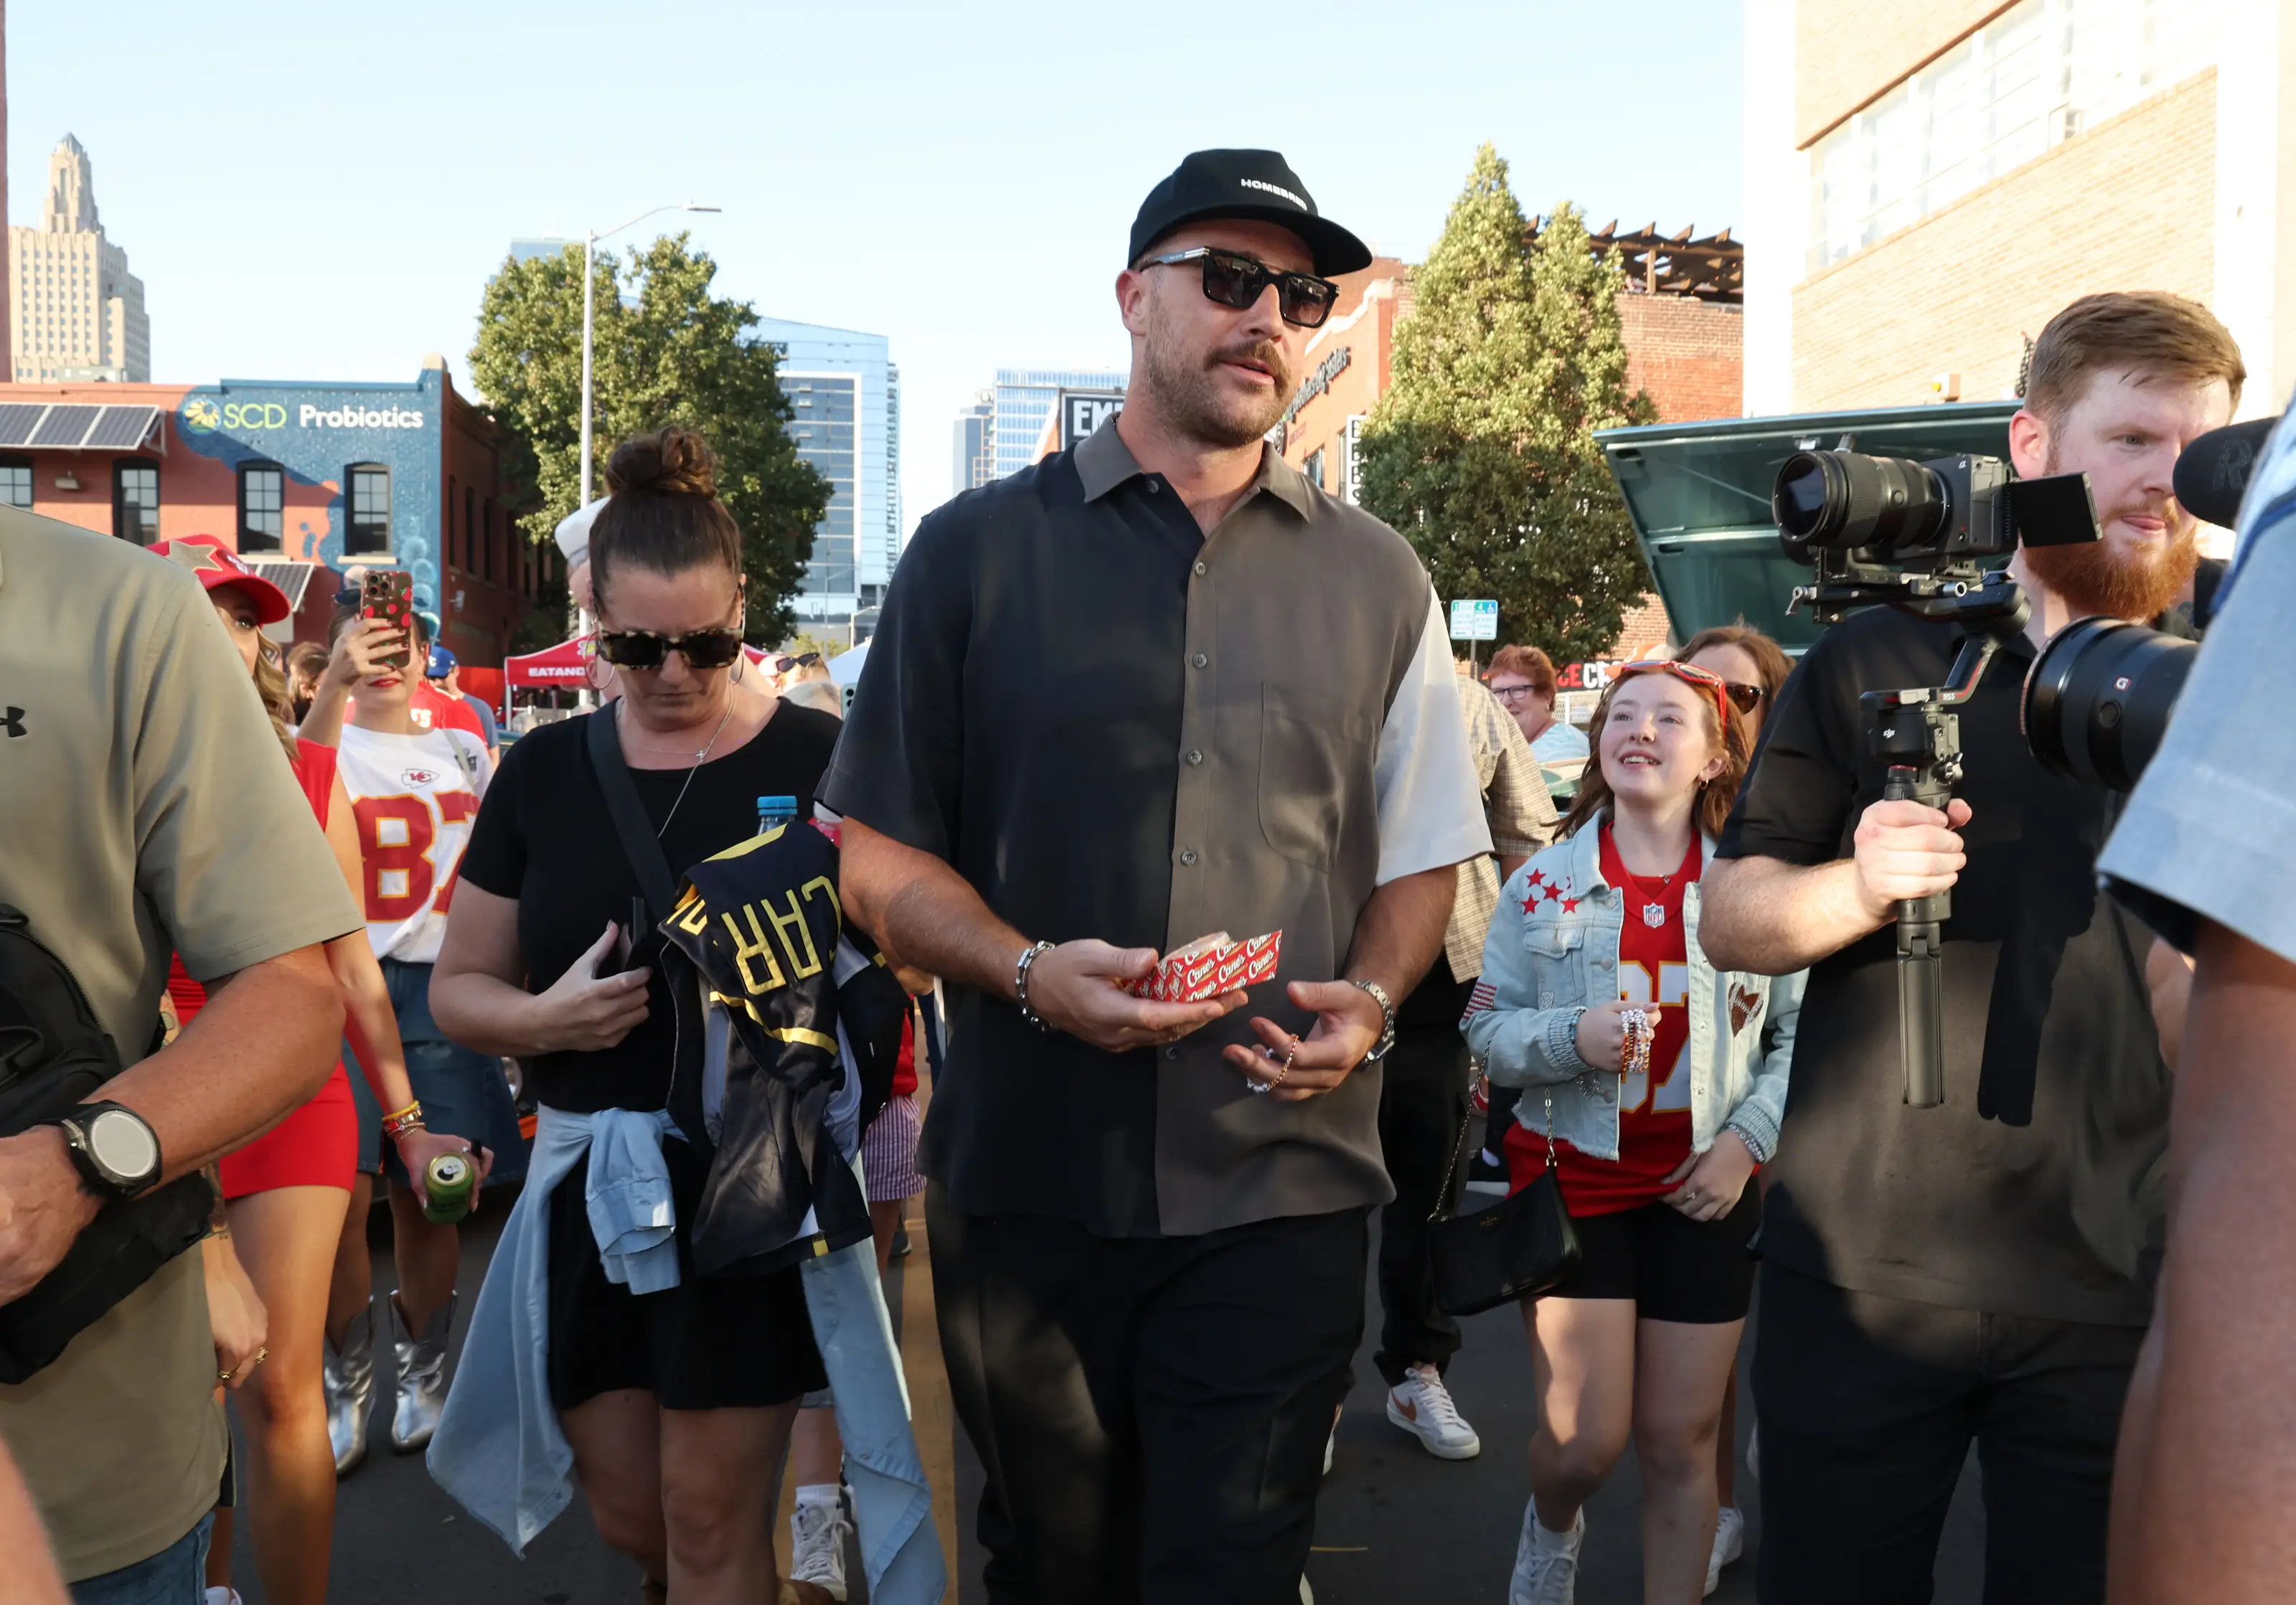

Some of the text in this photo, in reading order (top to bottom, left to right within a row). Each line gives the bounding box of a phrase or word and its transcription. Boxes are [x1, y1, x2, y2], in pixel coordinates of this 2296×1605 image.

[223, 403, 423, 429] SCD Probiotics
[2117, 677, 2129, 689] G
[352, 790, 481, 923] 87
[1187, 959, 1215, 988] Cane's
[1218, 954, 1246, 984] Cane's
[1248, 949, 1275, 979] Cane's
